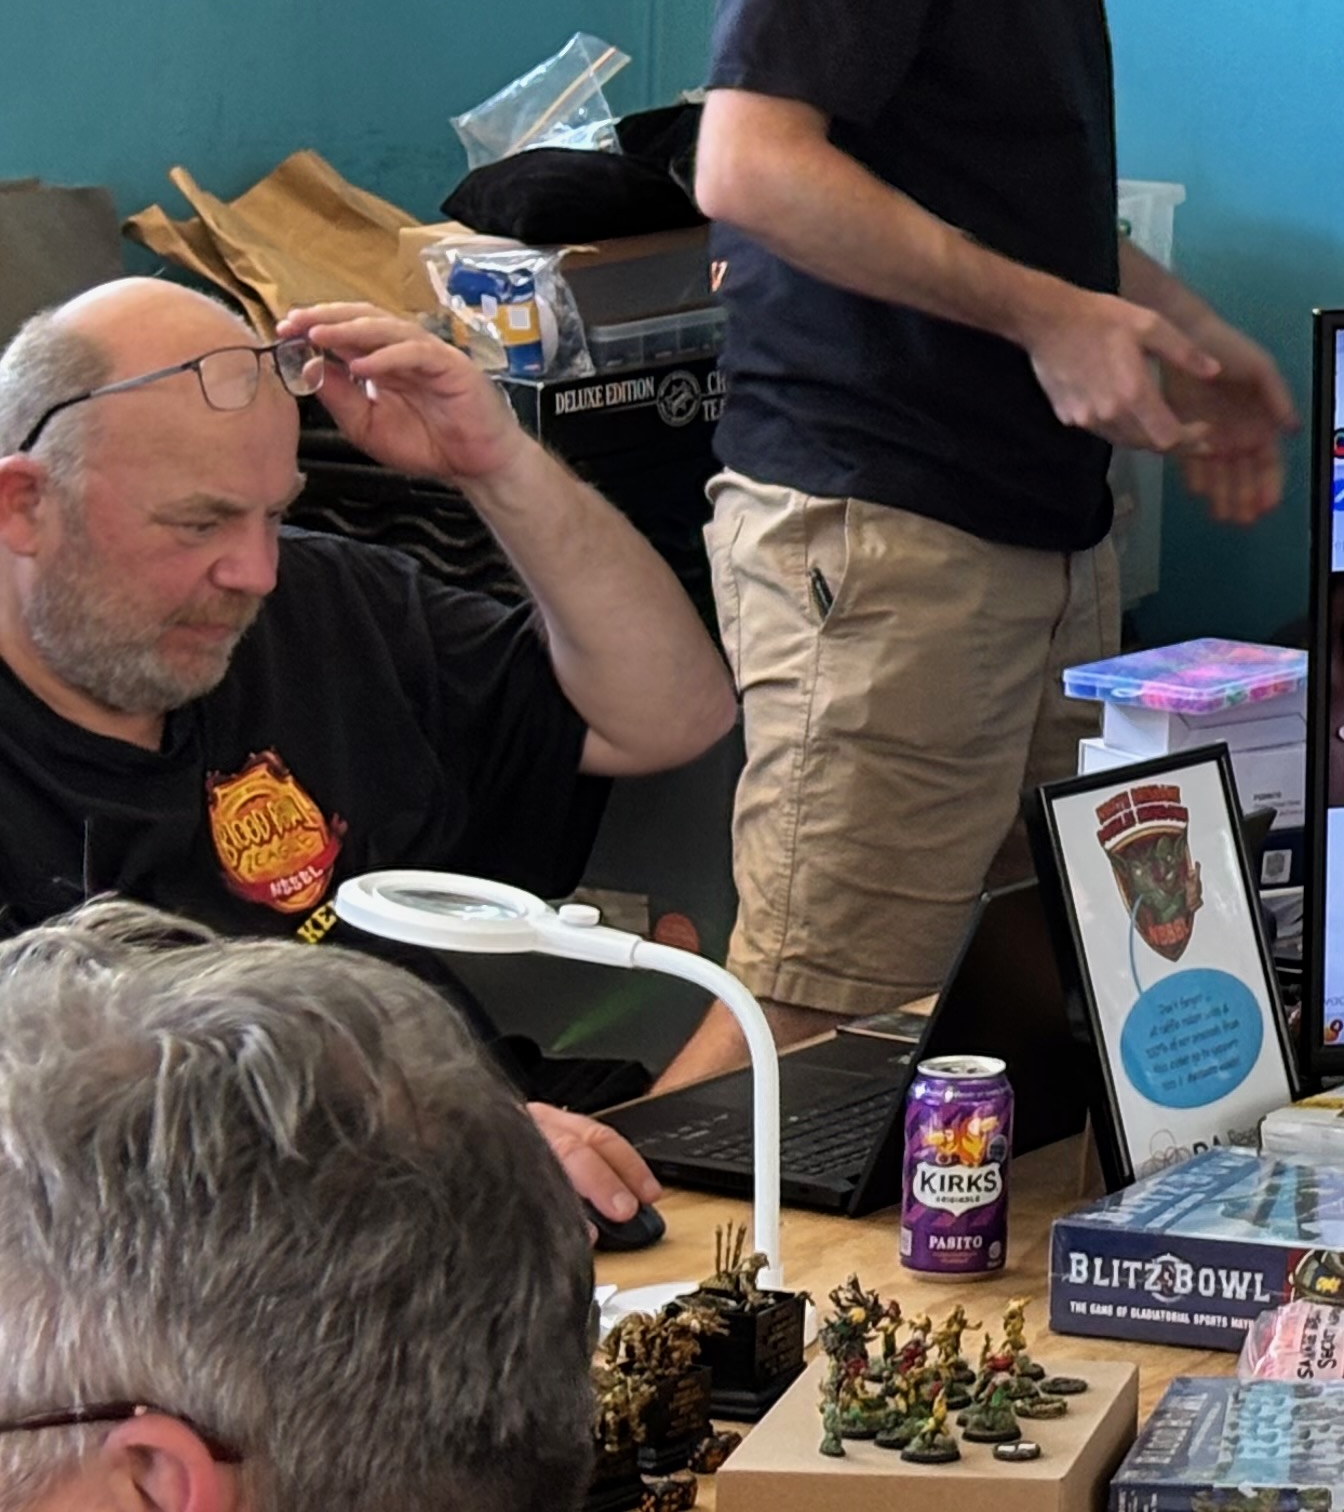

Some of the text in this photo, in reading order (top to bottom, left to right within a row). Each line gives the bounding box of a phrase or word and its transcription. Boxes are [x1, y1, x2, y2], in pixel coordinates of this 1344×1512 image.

[555, 376, 655, 416] DELUXE EDITION
[920, 1170, 998, 1195] KIRKS
[929, 1235, 983, 1250] PASITO
[1068, 1252, 1271, 1303] BLITZ BOWL
[1070, 1301, 1087, 1314] THE
[1090, 1303, 1113, 1318] GAME
[1116, 1306, 1128, 1318] OF
[1194, 1314, 1228, 1328] SPORTS
